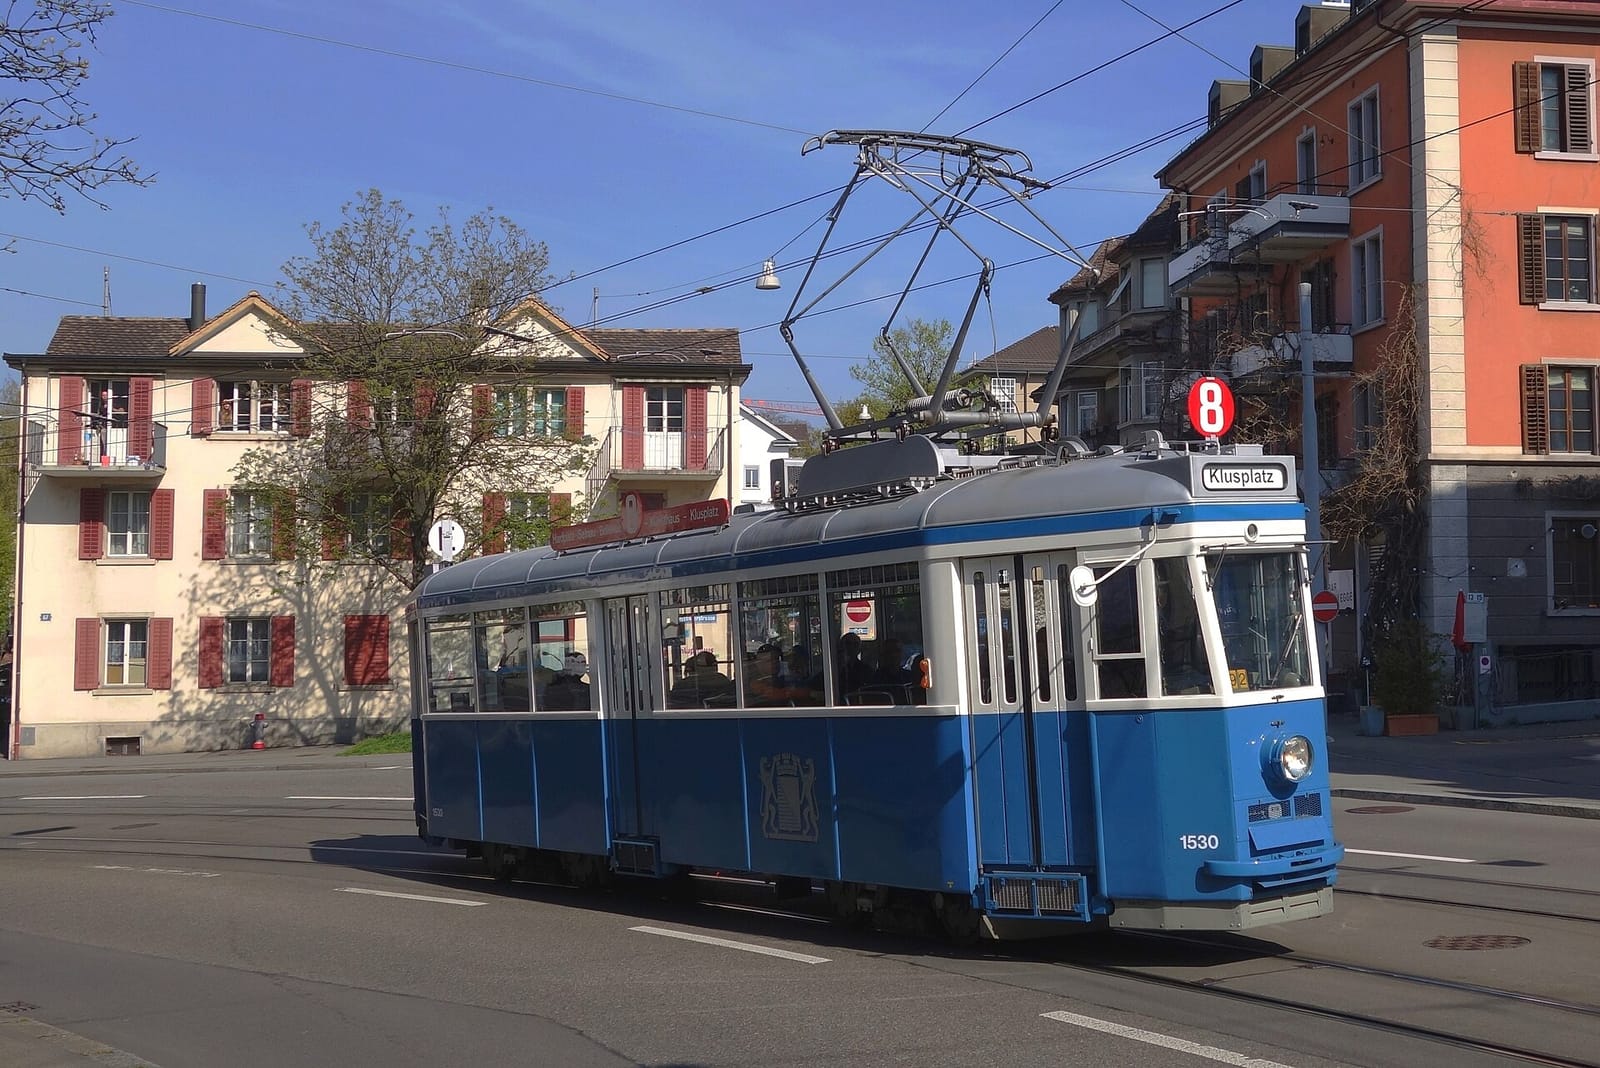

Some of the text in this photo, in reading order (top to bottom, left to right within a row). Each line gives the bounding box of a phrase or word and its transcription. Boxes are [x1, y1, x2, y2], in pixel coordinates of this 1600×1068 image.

[1199, 381, 1224, 433] 8
[1209, 469, 1274, 487] Klusplatz
[689, 506, 719, 521] Klusplatz
[1179, 835, 1219, 850] 1530
